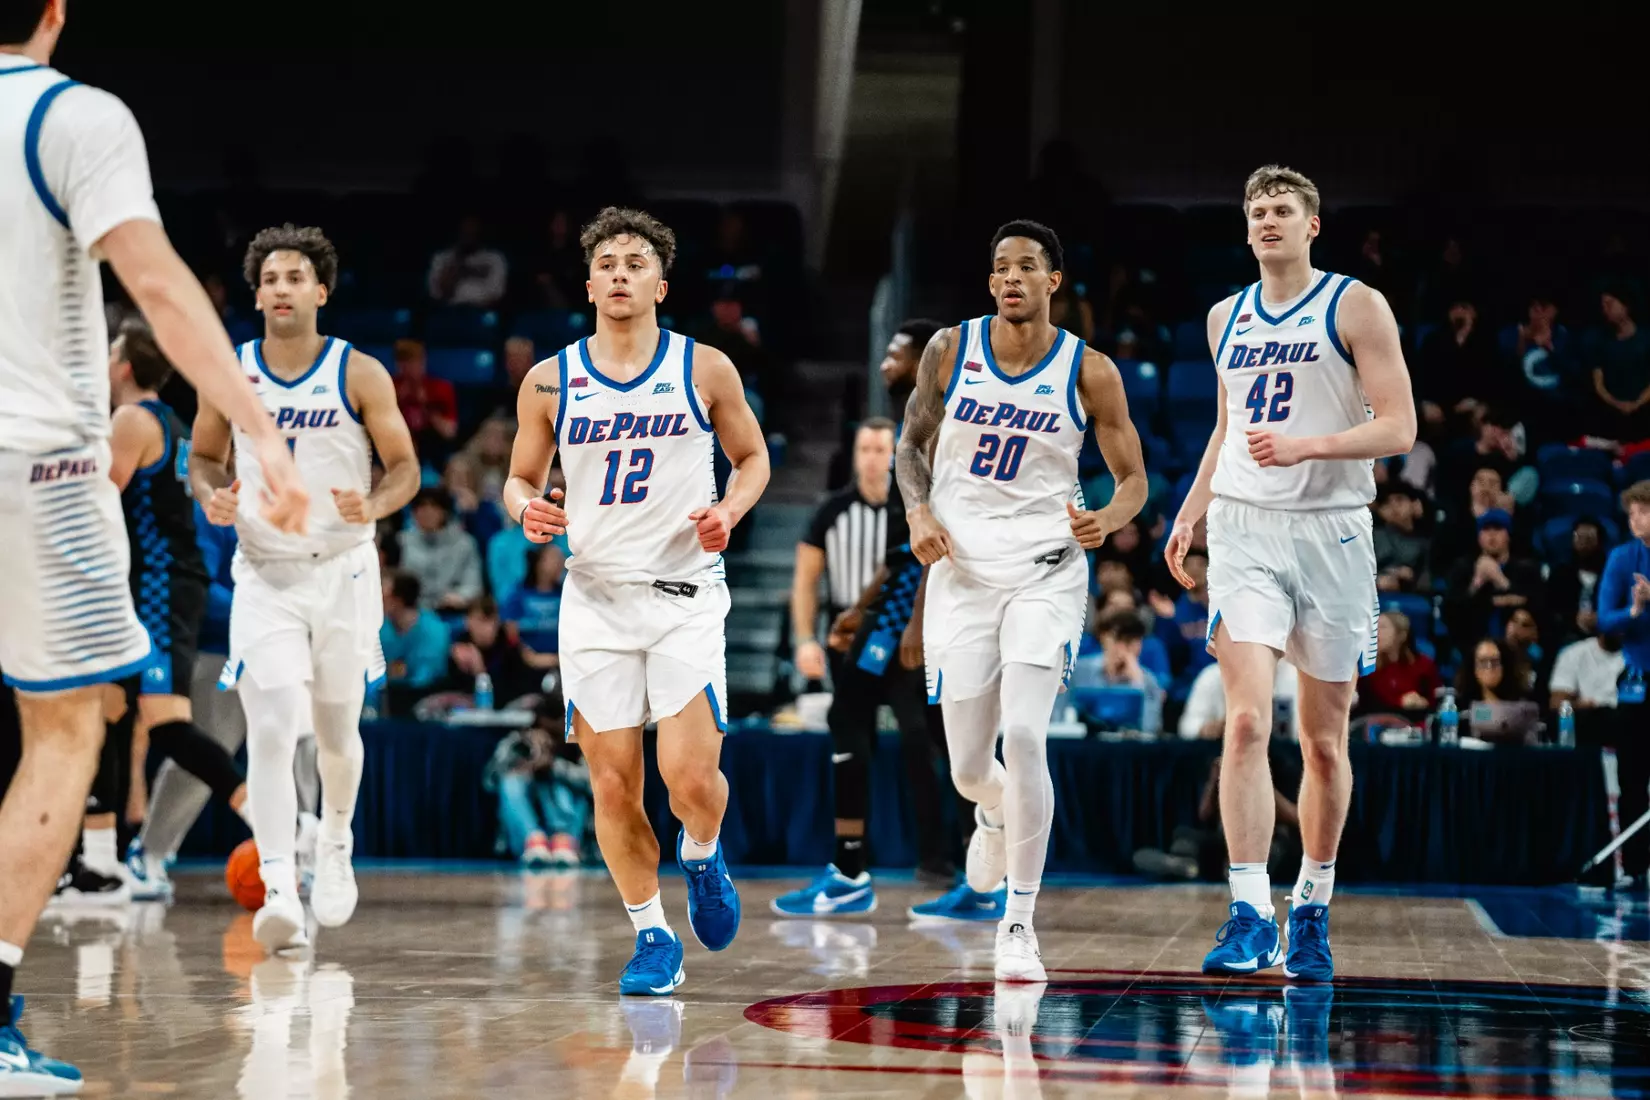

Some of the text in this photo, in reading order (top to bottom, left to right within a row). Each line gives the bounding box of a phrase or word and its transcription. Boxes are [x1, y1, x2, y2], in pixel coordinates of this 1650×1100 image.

[1245, 371, 1294, 424] 42
[599, 448, 655, 505] 12
[970, 433, 1029, 482] 20
